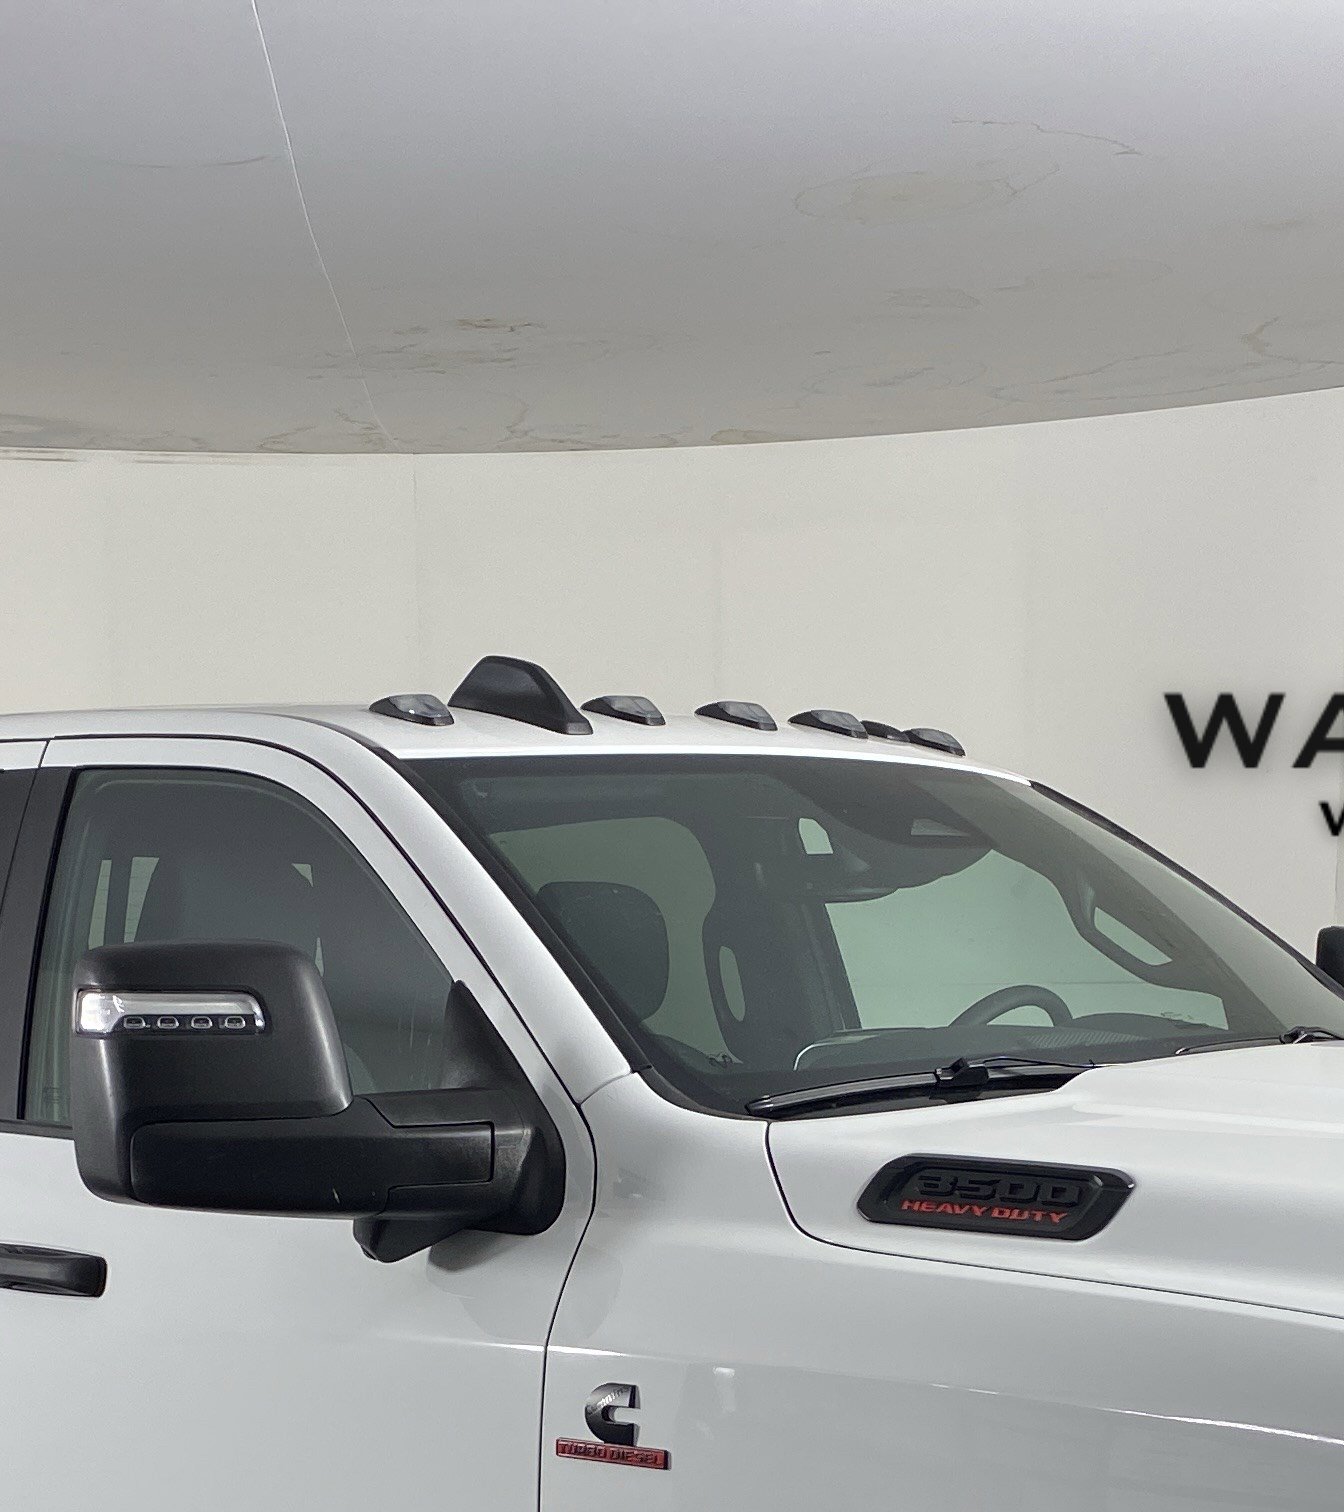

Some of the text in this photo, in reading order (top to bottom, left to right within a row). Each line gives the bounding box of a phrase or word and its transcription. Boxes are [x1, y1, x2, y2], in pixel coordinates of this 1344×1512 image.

[916, 1172, 1084, 1207] 3500
[900, 1199, 1069, 1224] HEAVY DUTY
